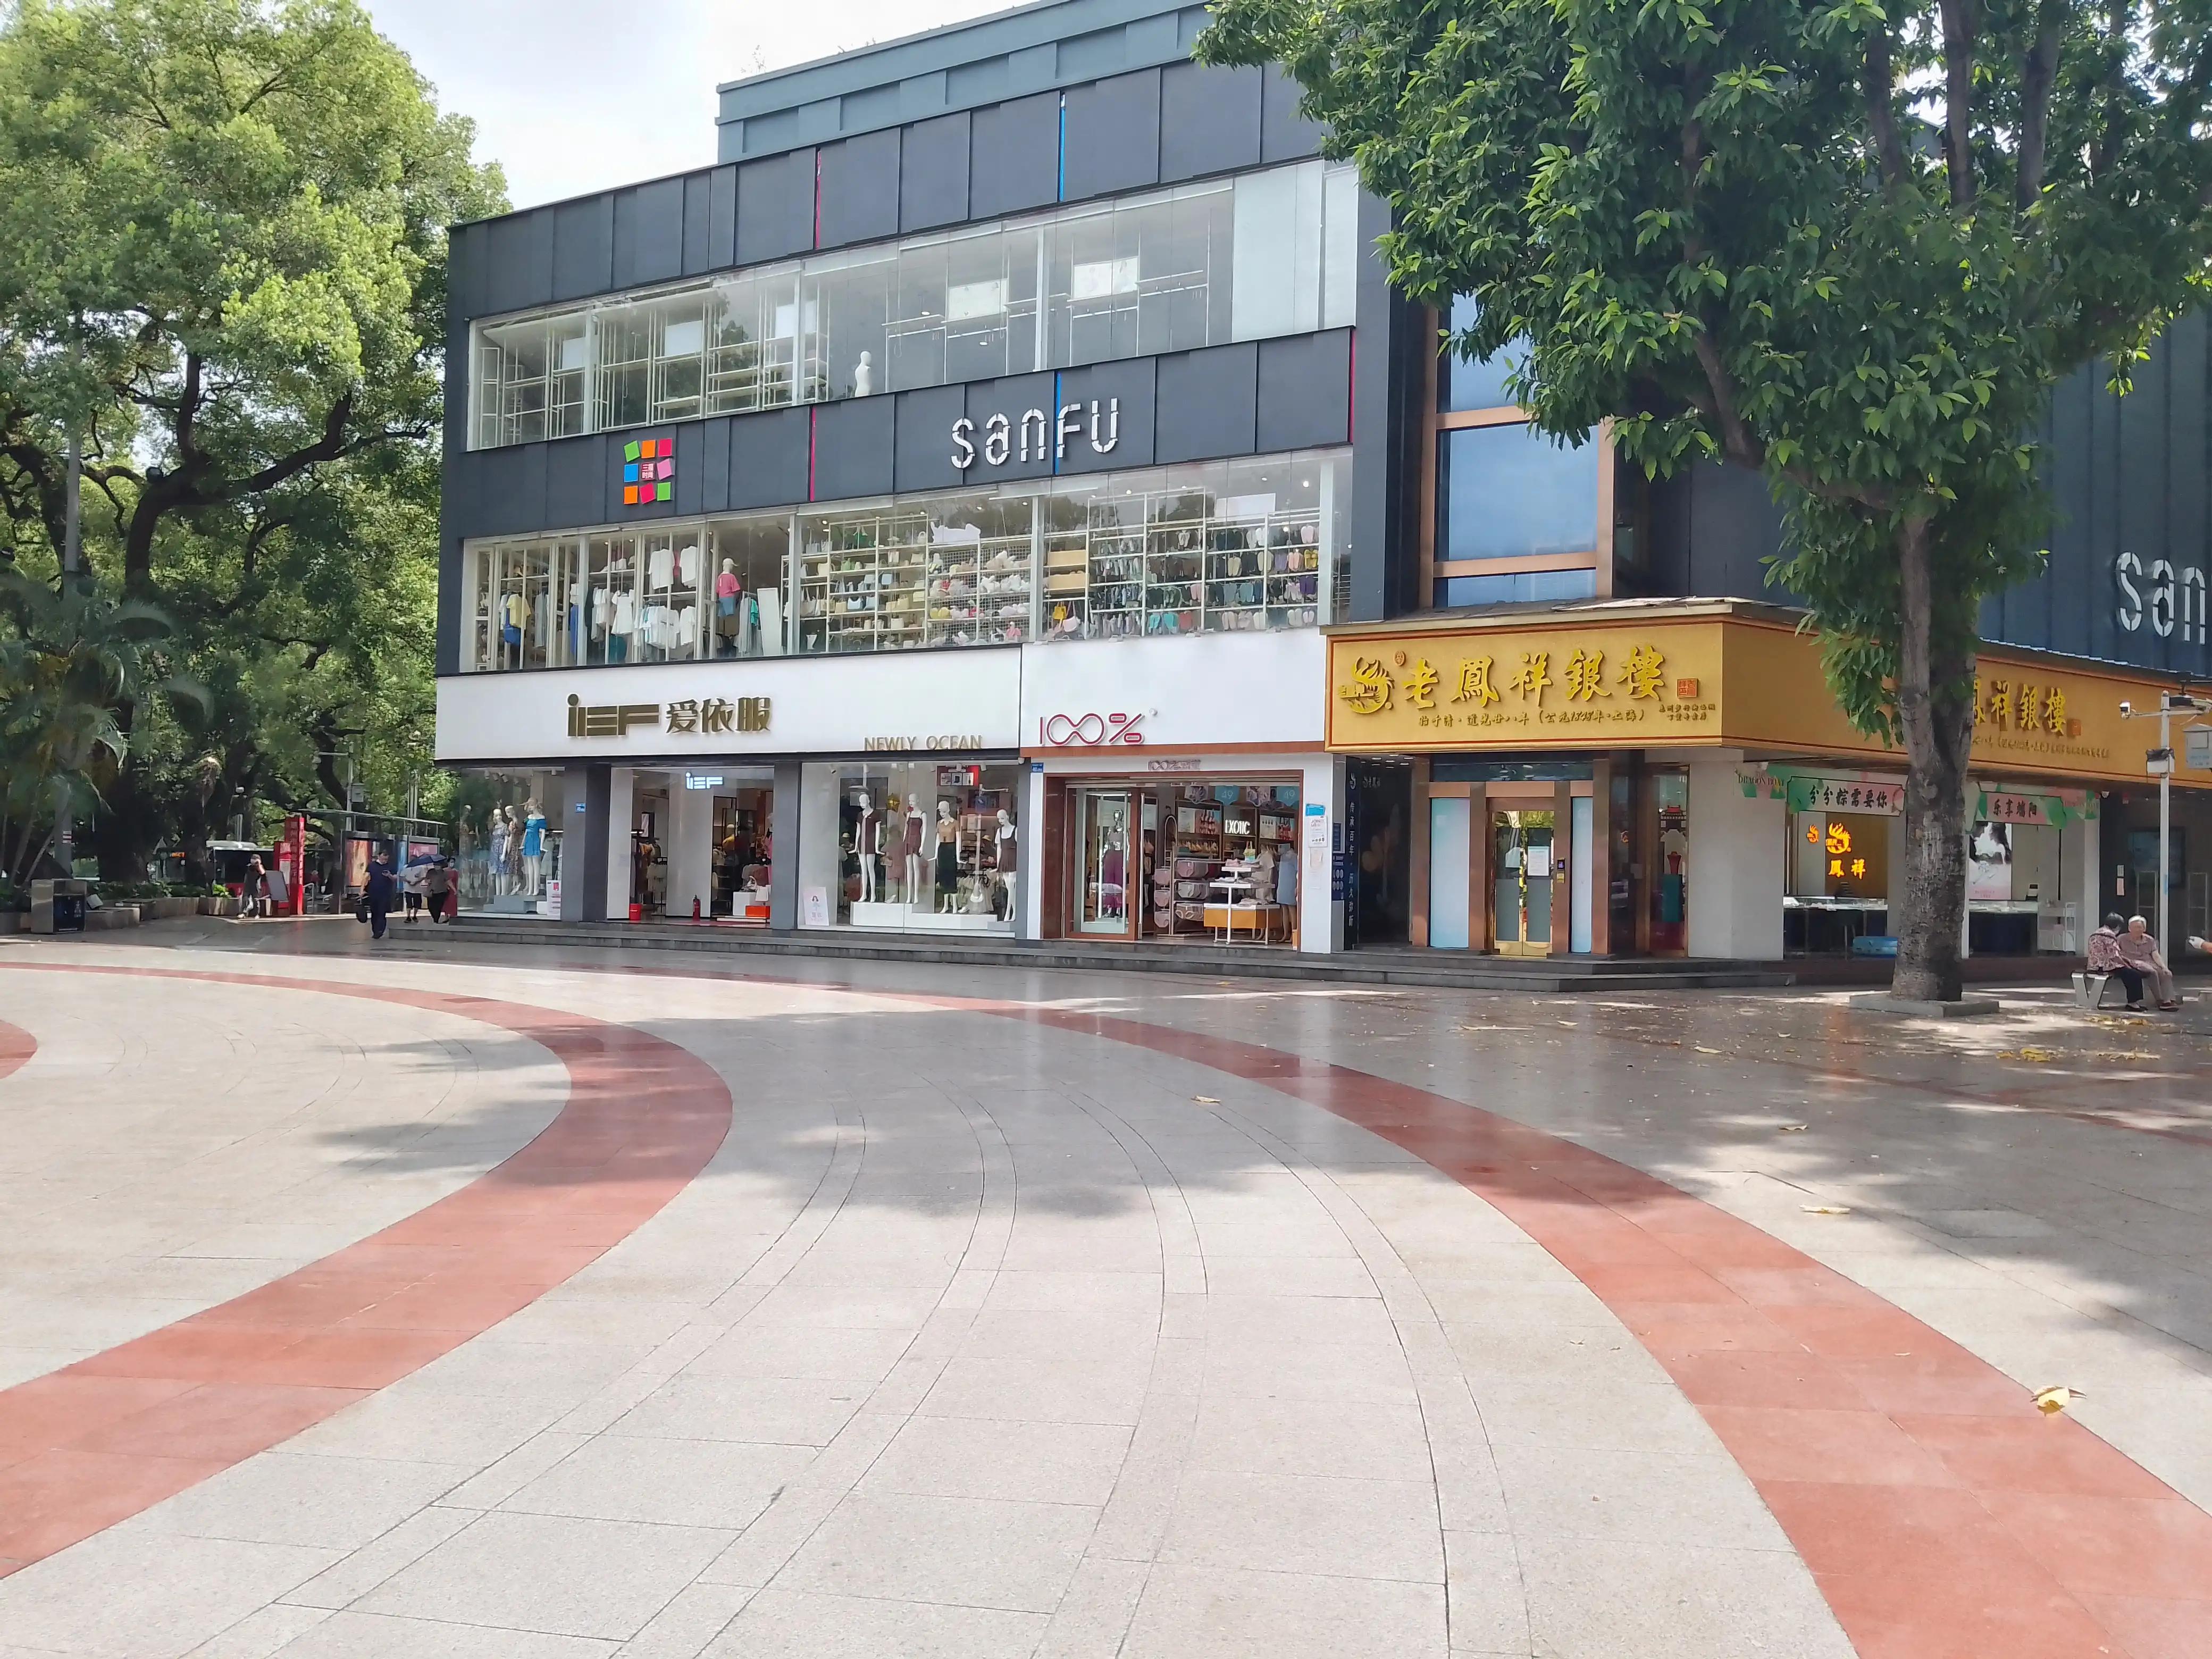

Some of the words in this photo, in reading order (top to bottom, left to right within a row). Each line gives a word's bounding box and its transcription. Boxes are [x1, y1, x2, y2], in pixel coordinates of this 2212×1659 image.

[665, 696, 772, 734] 爱依服
[1040, 711, 1145, 745] 100%
[864, 736, 917, 750] NEWLY
[926, 735, 983, 749] OCEAN
